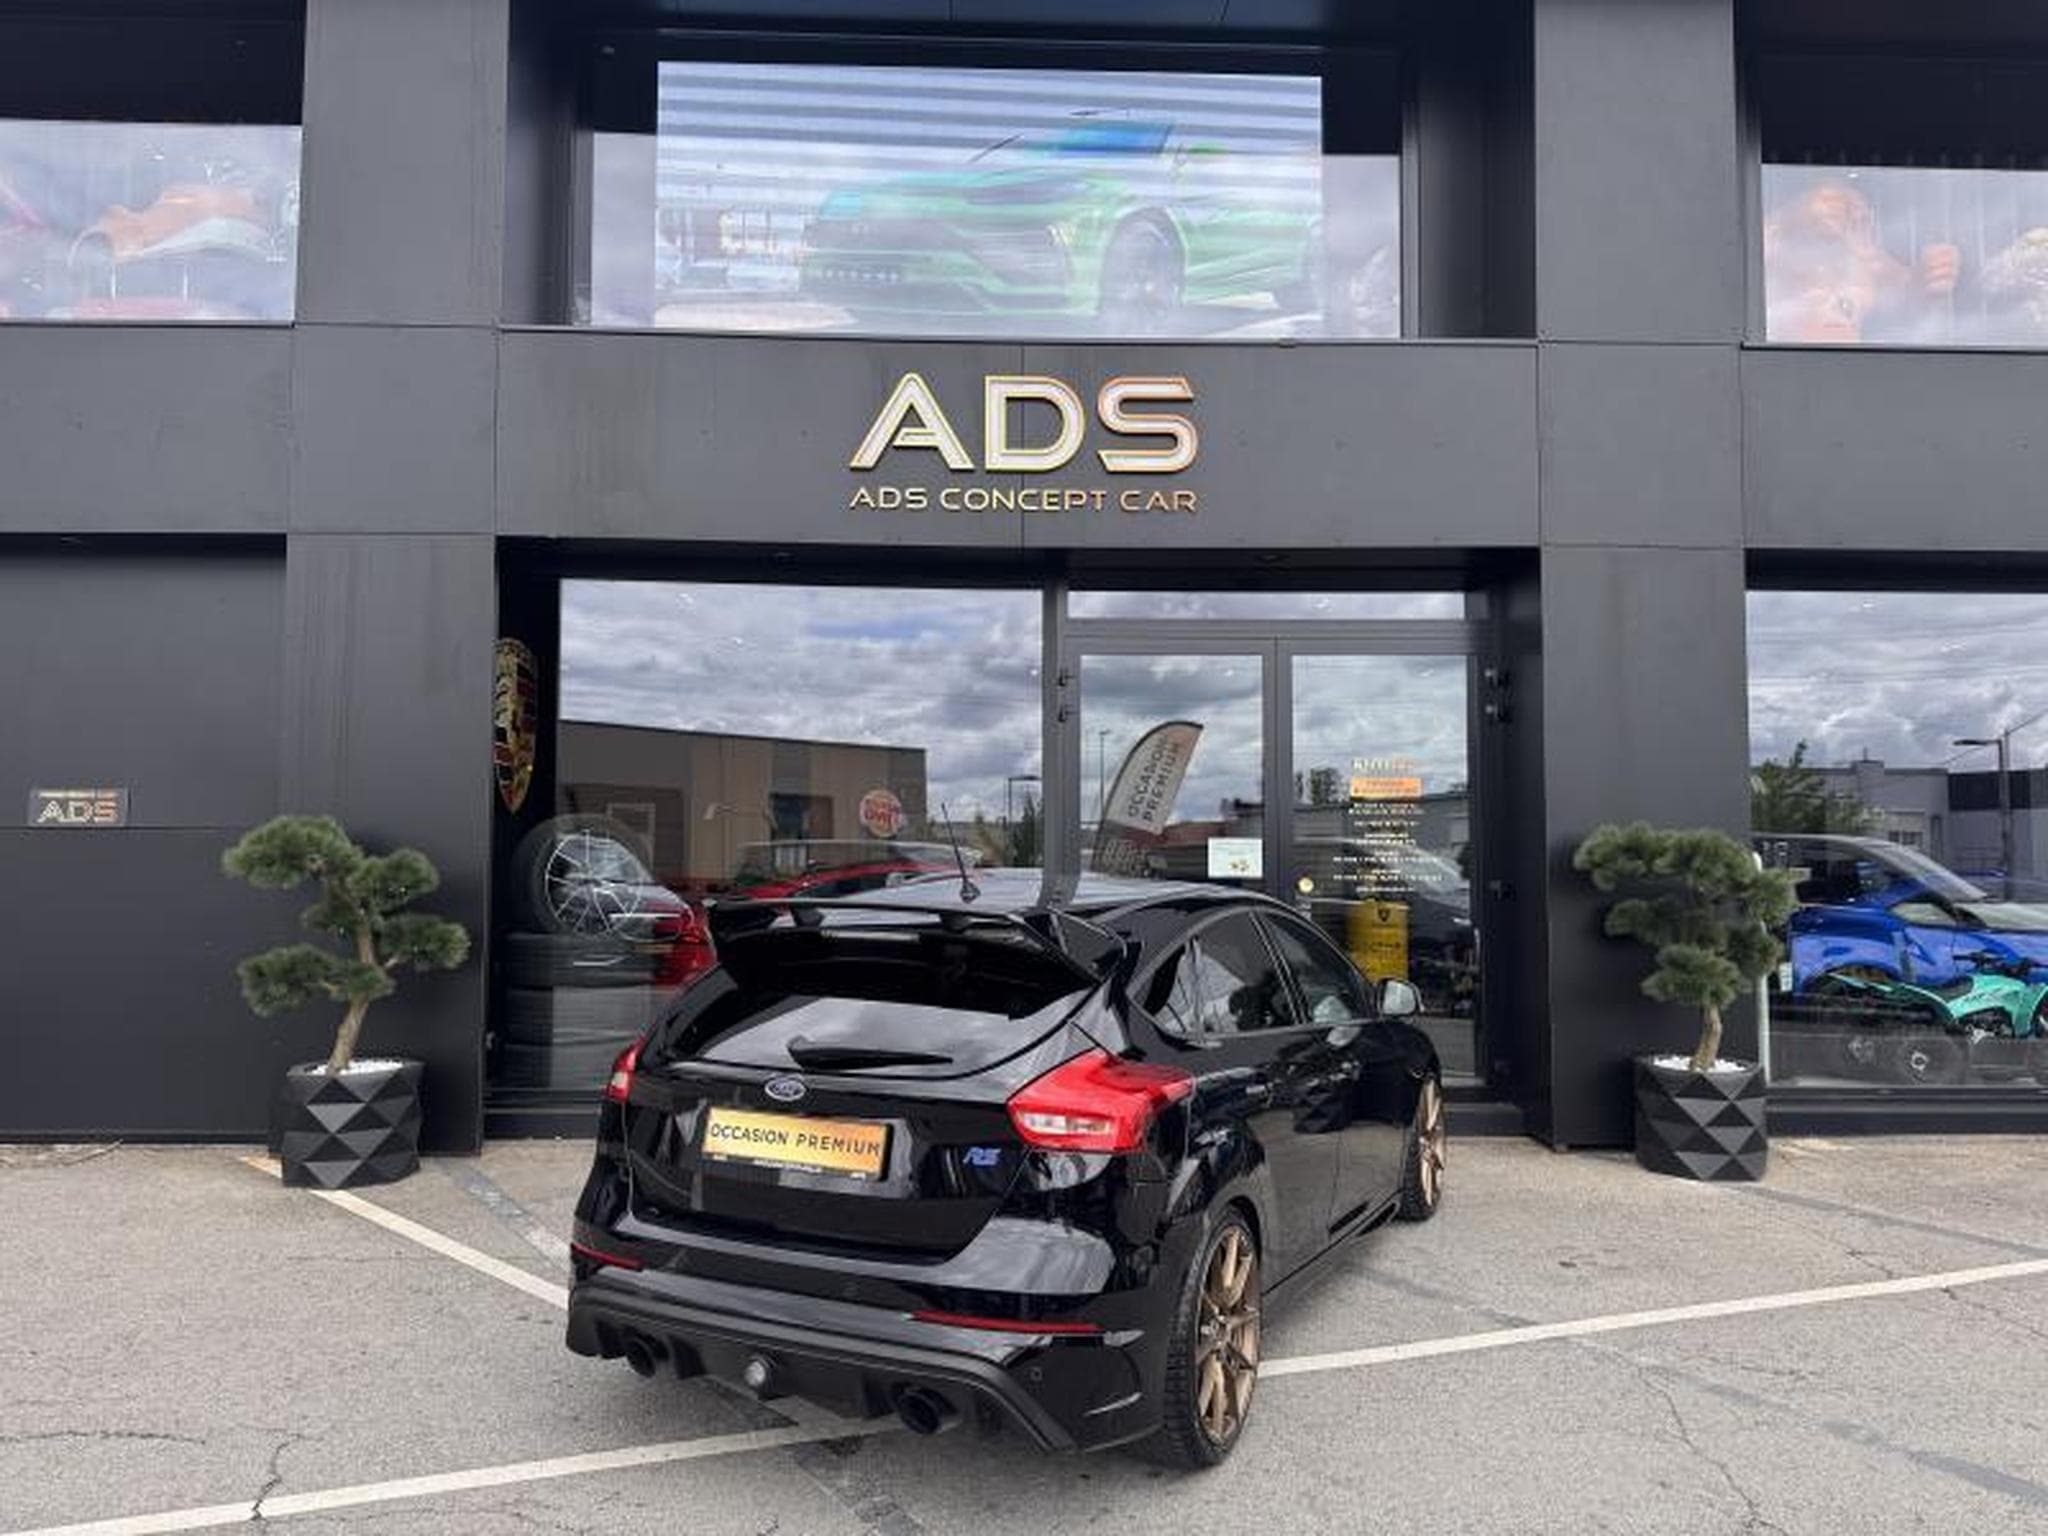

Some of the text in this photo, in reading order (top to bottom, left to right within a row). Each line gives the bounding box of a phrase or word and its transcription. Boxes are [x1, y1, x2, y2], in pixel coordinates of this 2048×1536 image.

[850, 372, 1197, 473] ADS
[850, 487, 1197, 512] ADS CONCEPT CAR
[37, 799, 119, 823] ADS
[710, 1122, 881, 1157] OCCASION PREMIUM
